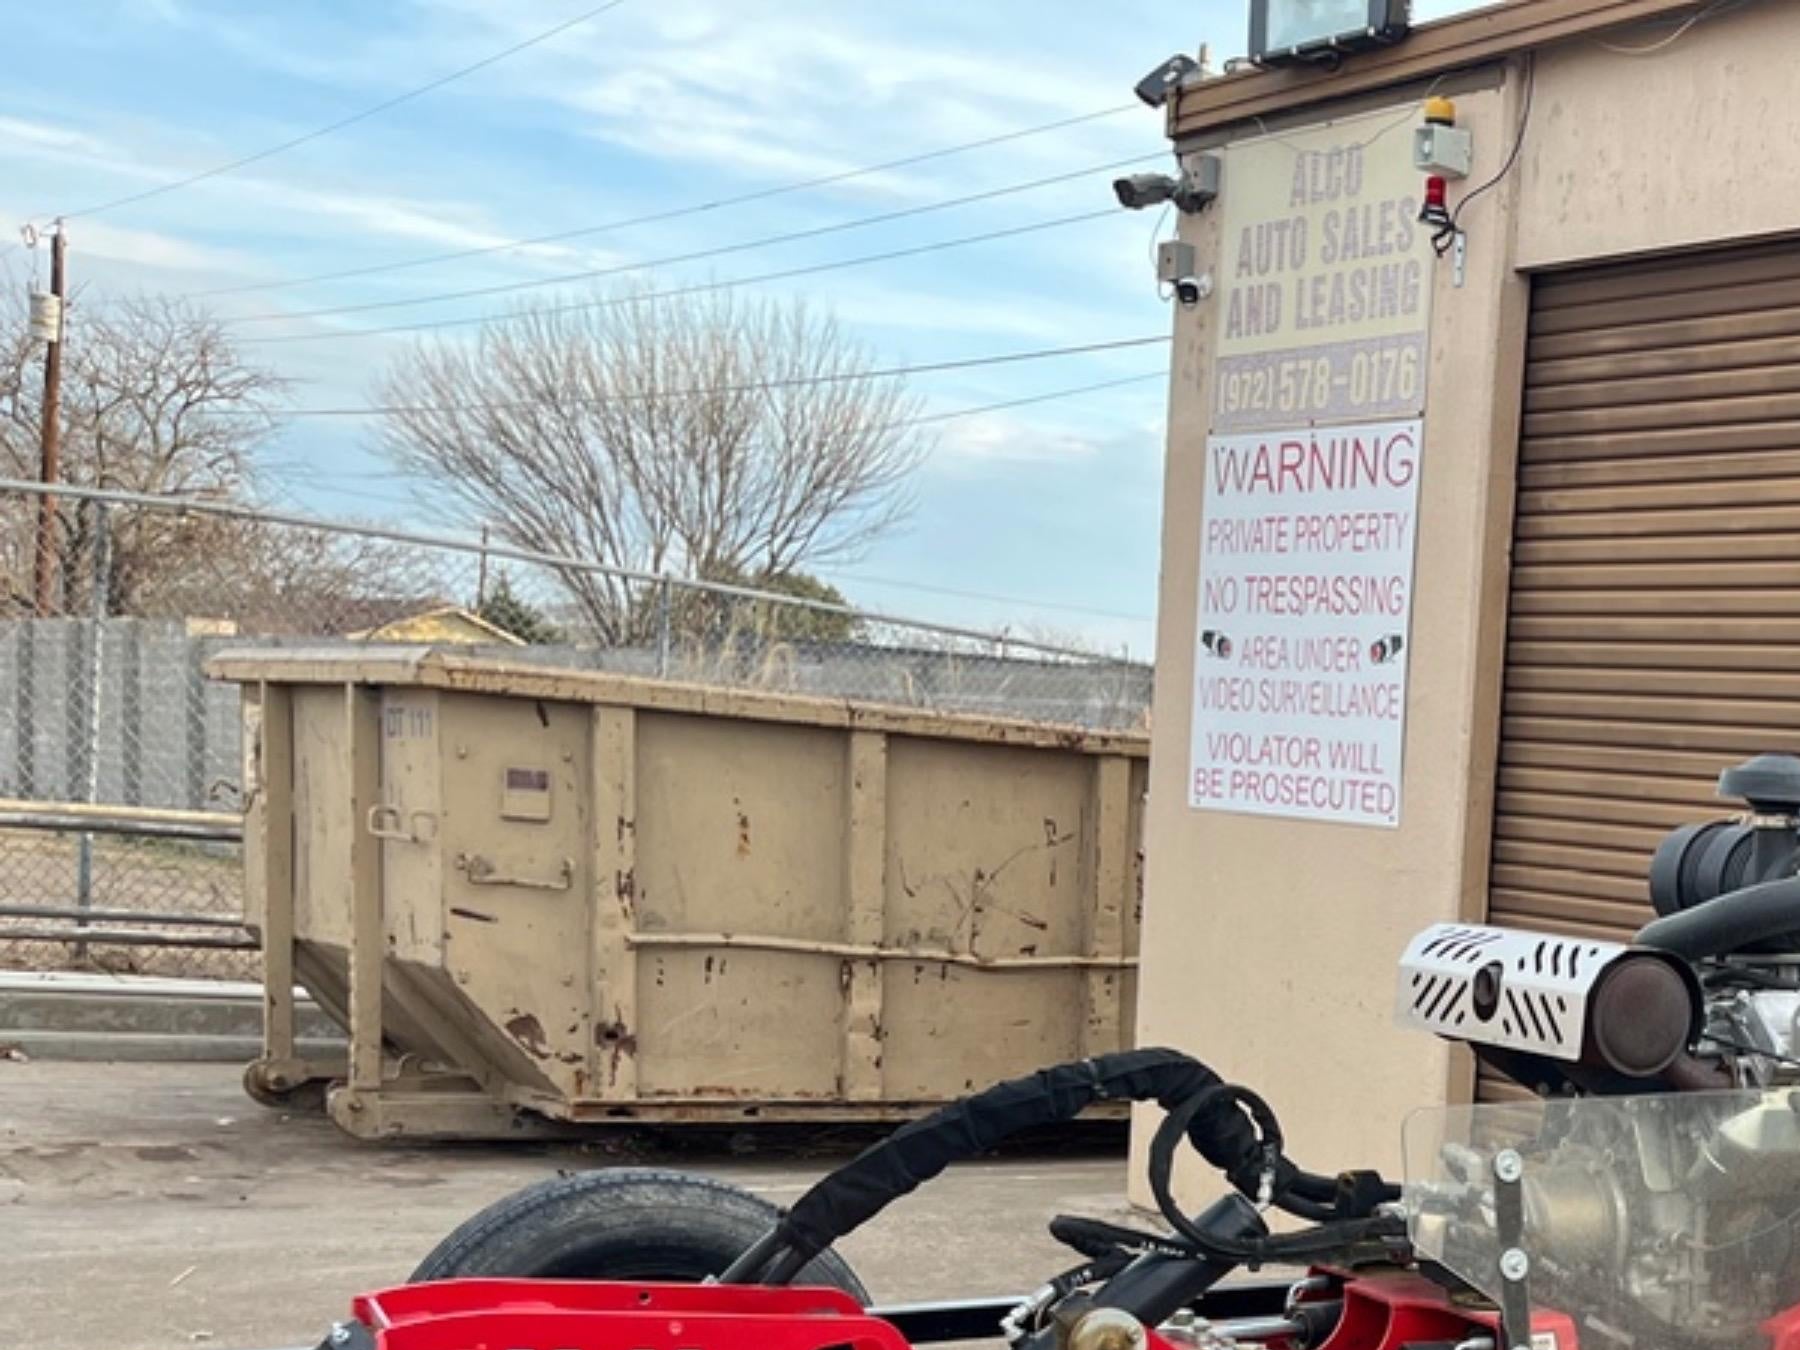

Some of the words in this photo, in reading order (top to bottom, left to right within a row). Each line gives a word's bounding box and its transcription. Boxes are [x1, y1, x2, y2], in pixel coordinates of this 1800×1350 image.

[1235, 215, 1308, 278] AUTO
[1320, 196, 1416, 264] SALES
[1225, 282, 1283, 339] AND
[1295, 258, 1420, 330] LEASING
[1213, 432, 1414, 496] WARNING
[1207, 516, 1289, 554] PRIVATE
[1295, 512, 1408, 552] PROPERTY
[1204, 576, 1238, 614] NO
[1244, 575, 1405, 616] TRESPASSING
[1239, 635, 1289, 671] AREA
[1295, 636, 1361, 673] UNDER
[1200, 676, 1254, 712] VIDEO
[1259, 678, 1400, 720] SURVEILLANCE
[1207, 731, 1321, 769] VIOLATOR
[1327, 740, 1385, 775] WILL
[1194, 767, 1224, 799] BE
[1229, 770, 1396, 815] PROSECUTED
